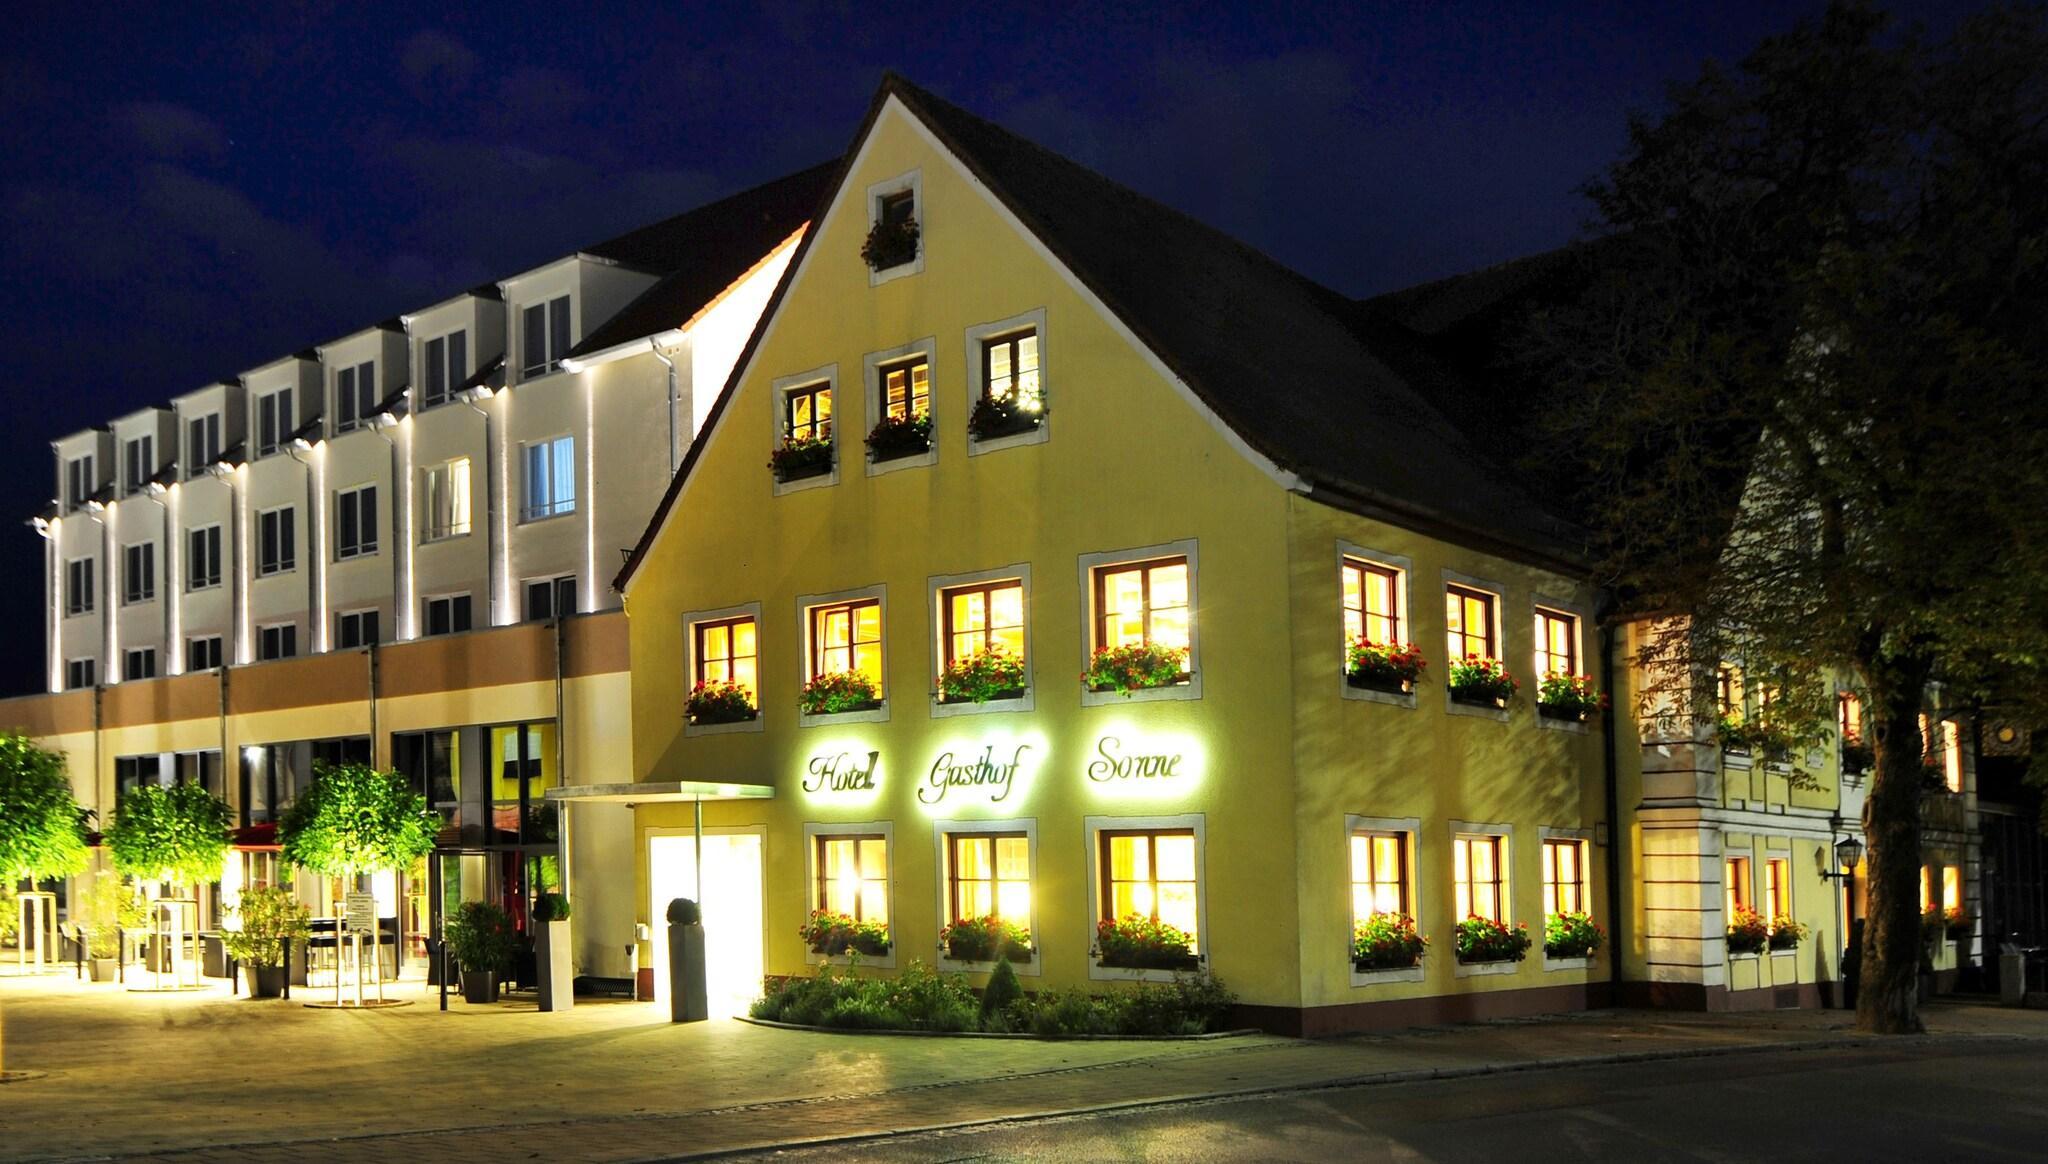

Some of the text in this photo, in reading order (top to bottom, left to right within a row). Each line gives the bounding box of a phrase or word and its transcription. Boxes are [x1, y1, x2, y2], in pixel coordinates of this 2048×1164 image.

[802, 736, 1182, 804] Hotel Gasthof Sonne
